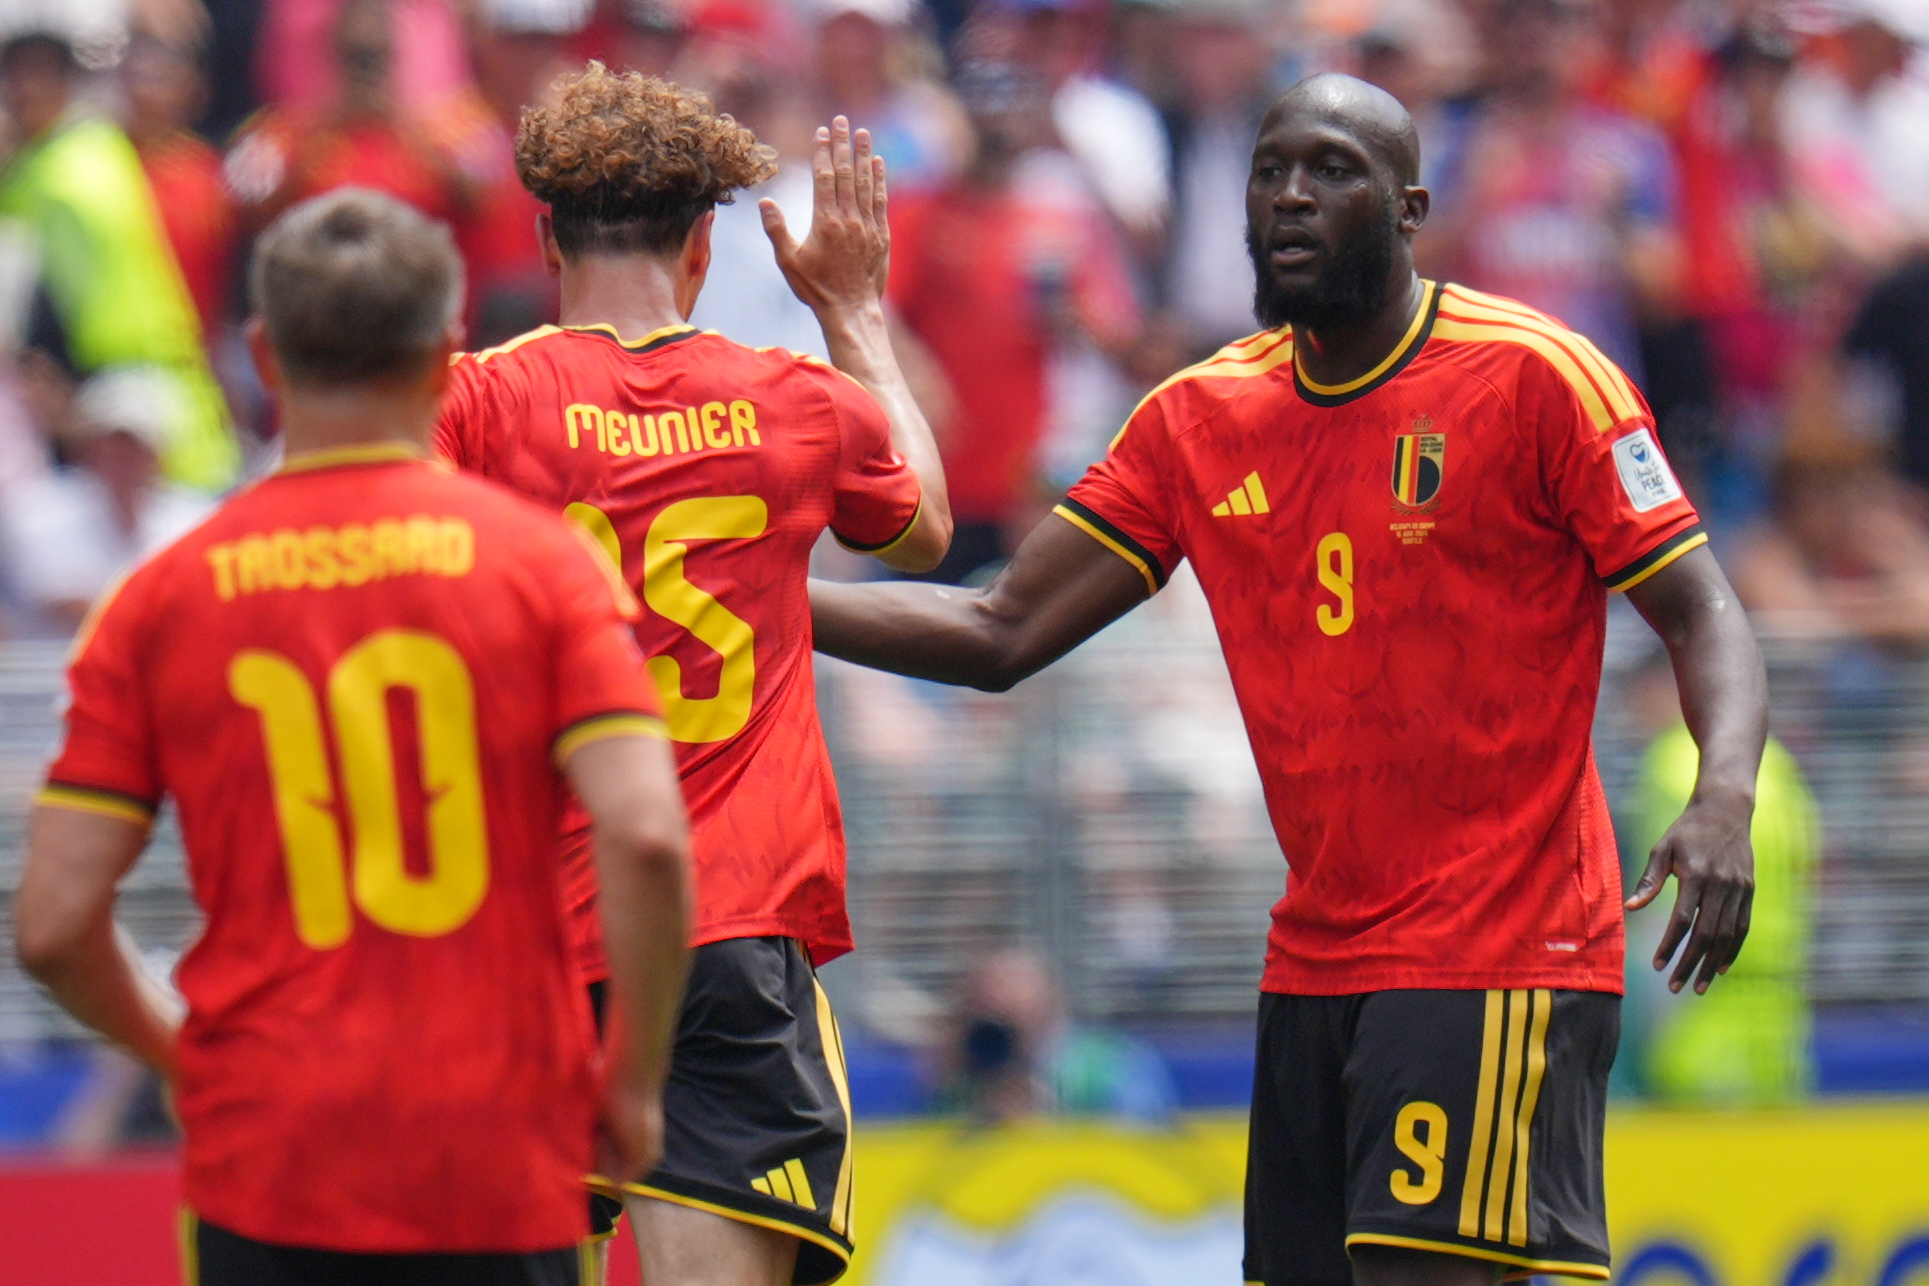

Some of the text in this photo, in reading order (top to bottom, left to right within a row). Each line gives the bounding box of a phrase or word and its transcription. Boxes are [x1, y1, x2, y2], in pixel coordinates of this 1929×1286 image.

[566, 399, 761, 457] MEUNIER
[208, 514, 475, 600] TROSSARD
[1317, 532, 1355, 636] 9
[229, 630, 490, 949] 10
[1390, 1101, 1448, 1205] 9
